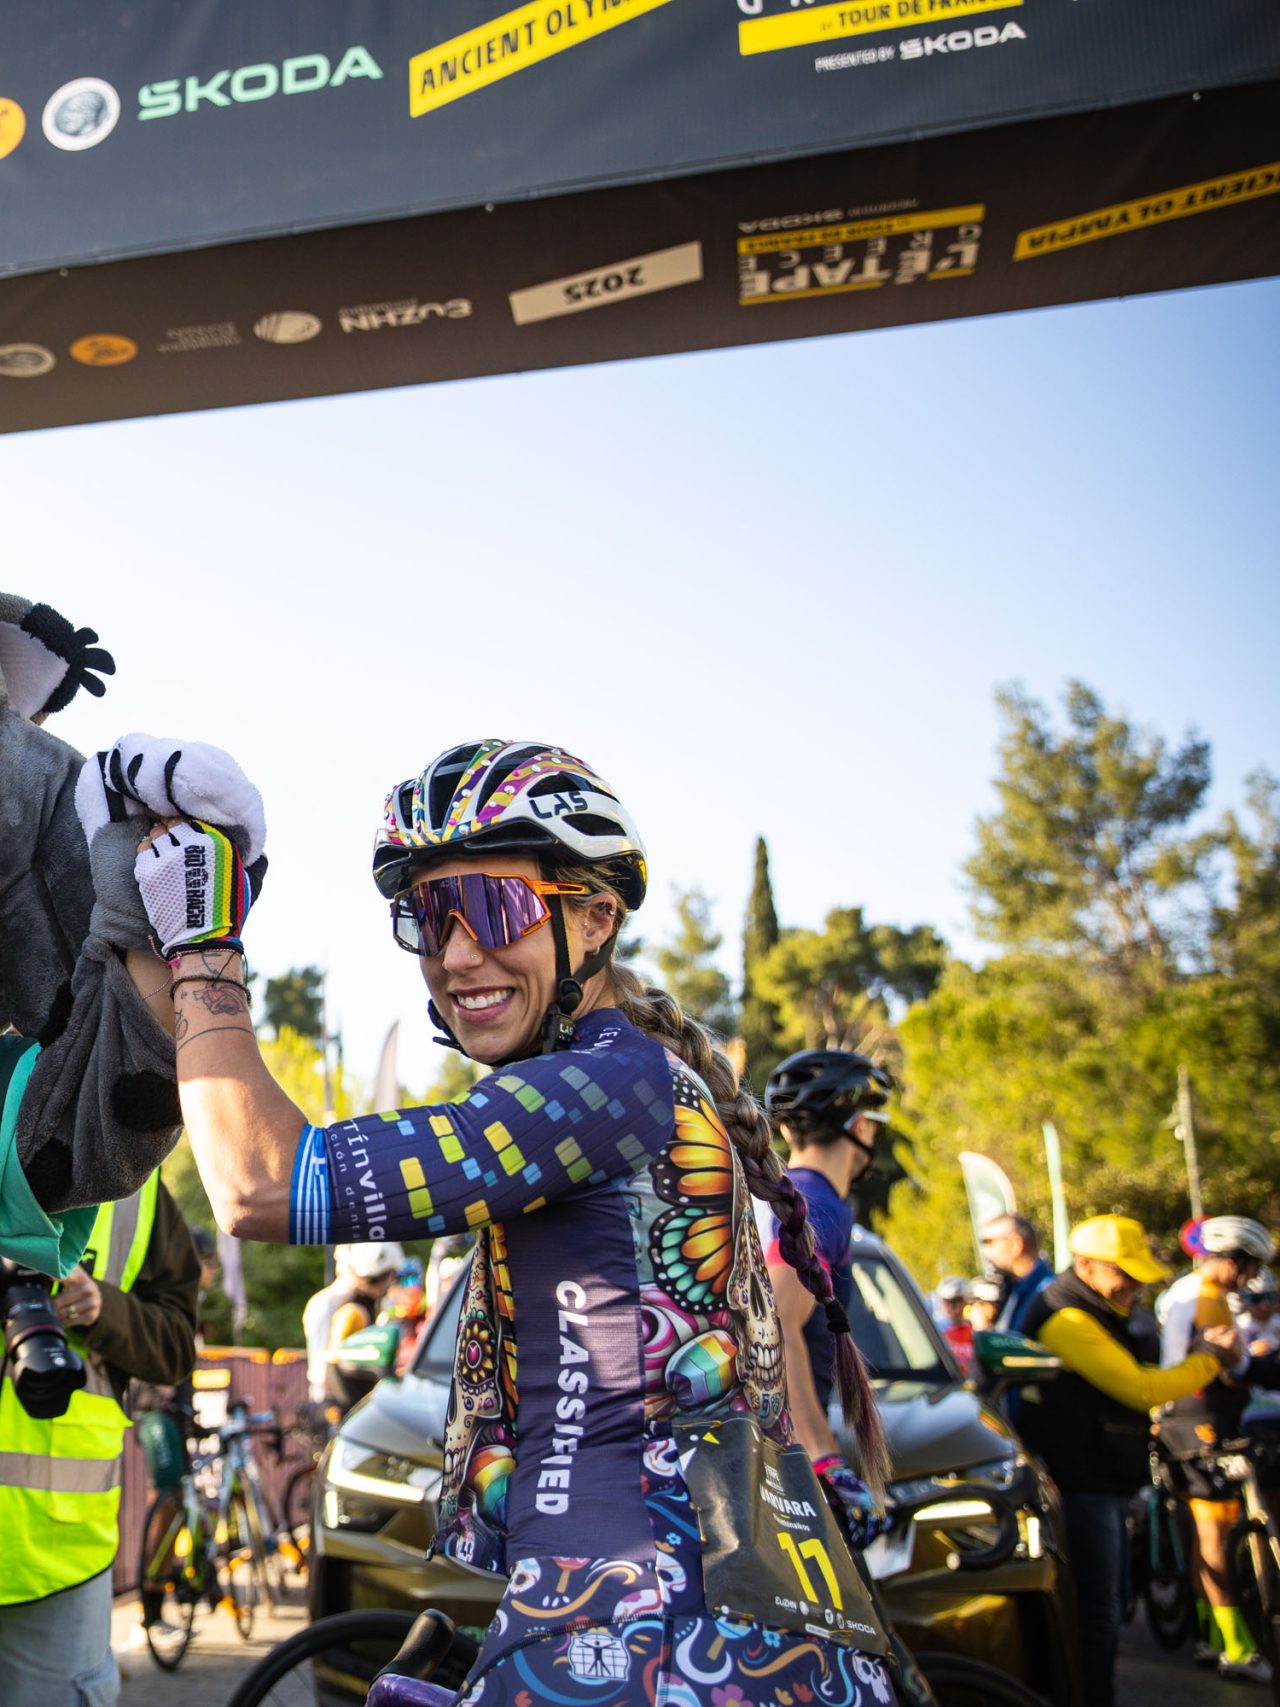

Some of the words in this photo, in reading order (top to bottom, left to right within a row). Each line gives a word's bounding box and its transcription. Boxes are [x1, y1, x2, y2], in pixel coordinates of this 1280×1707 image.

[420, 17, 538, 95] ANCIENT
[546, 0, 632, 36] OLY
[563, 265, 646, 305] 2025
[775, 1531, 844, 1611] 17
